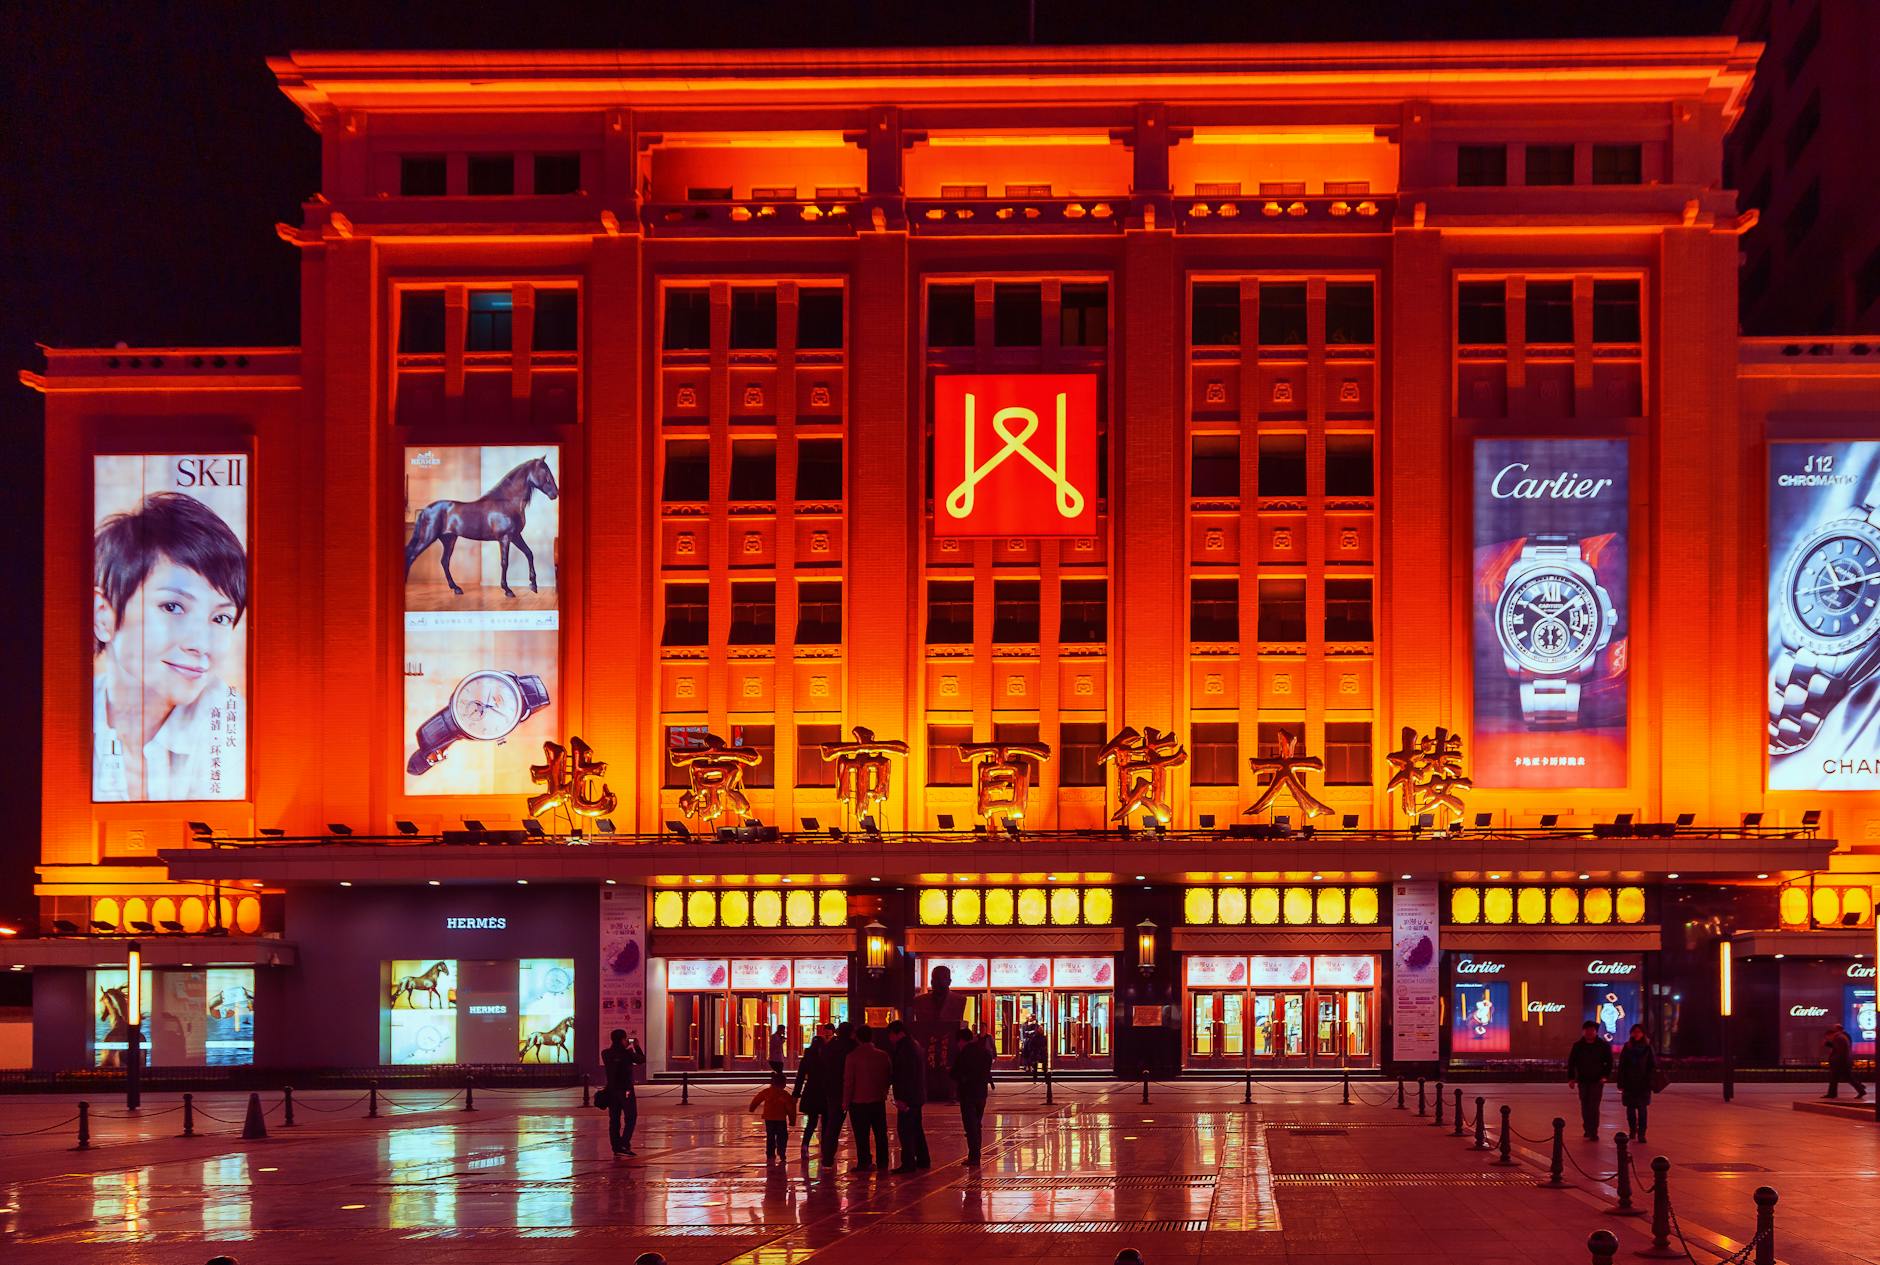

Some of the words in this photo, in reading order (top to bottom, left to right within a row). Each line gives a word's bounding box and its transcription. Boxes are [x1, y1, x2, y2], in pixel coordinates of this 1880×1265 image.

[176, 458, 243, 488] SK-II
[1491, 463, 1612, 499] Cartier
[527, 726, 1473, 823] 北京市百货大楼
[1456, 959, 1505, 974] Cartier
[1587, 960, 1636, 974] Cartier
[1528, 1001, 1565, 1012] Cartier
[1790, 1005, 1828, 1017] Cartier
